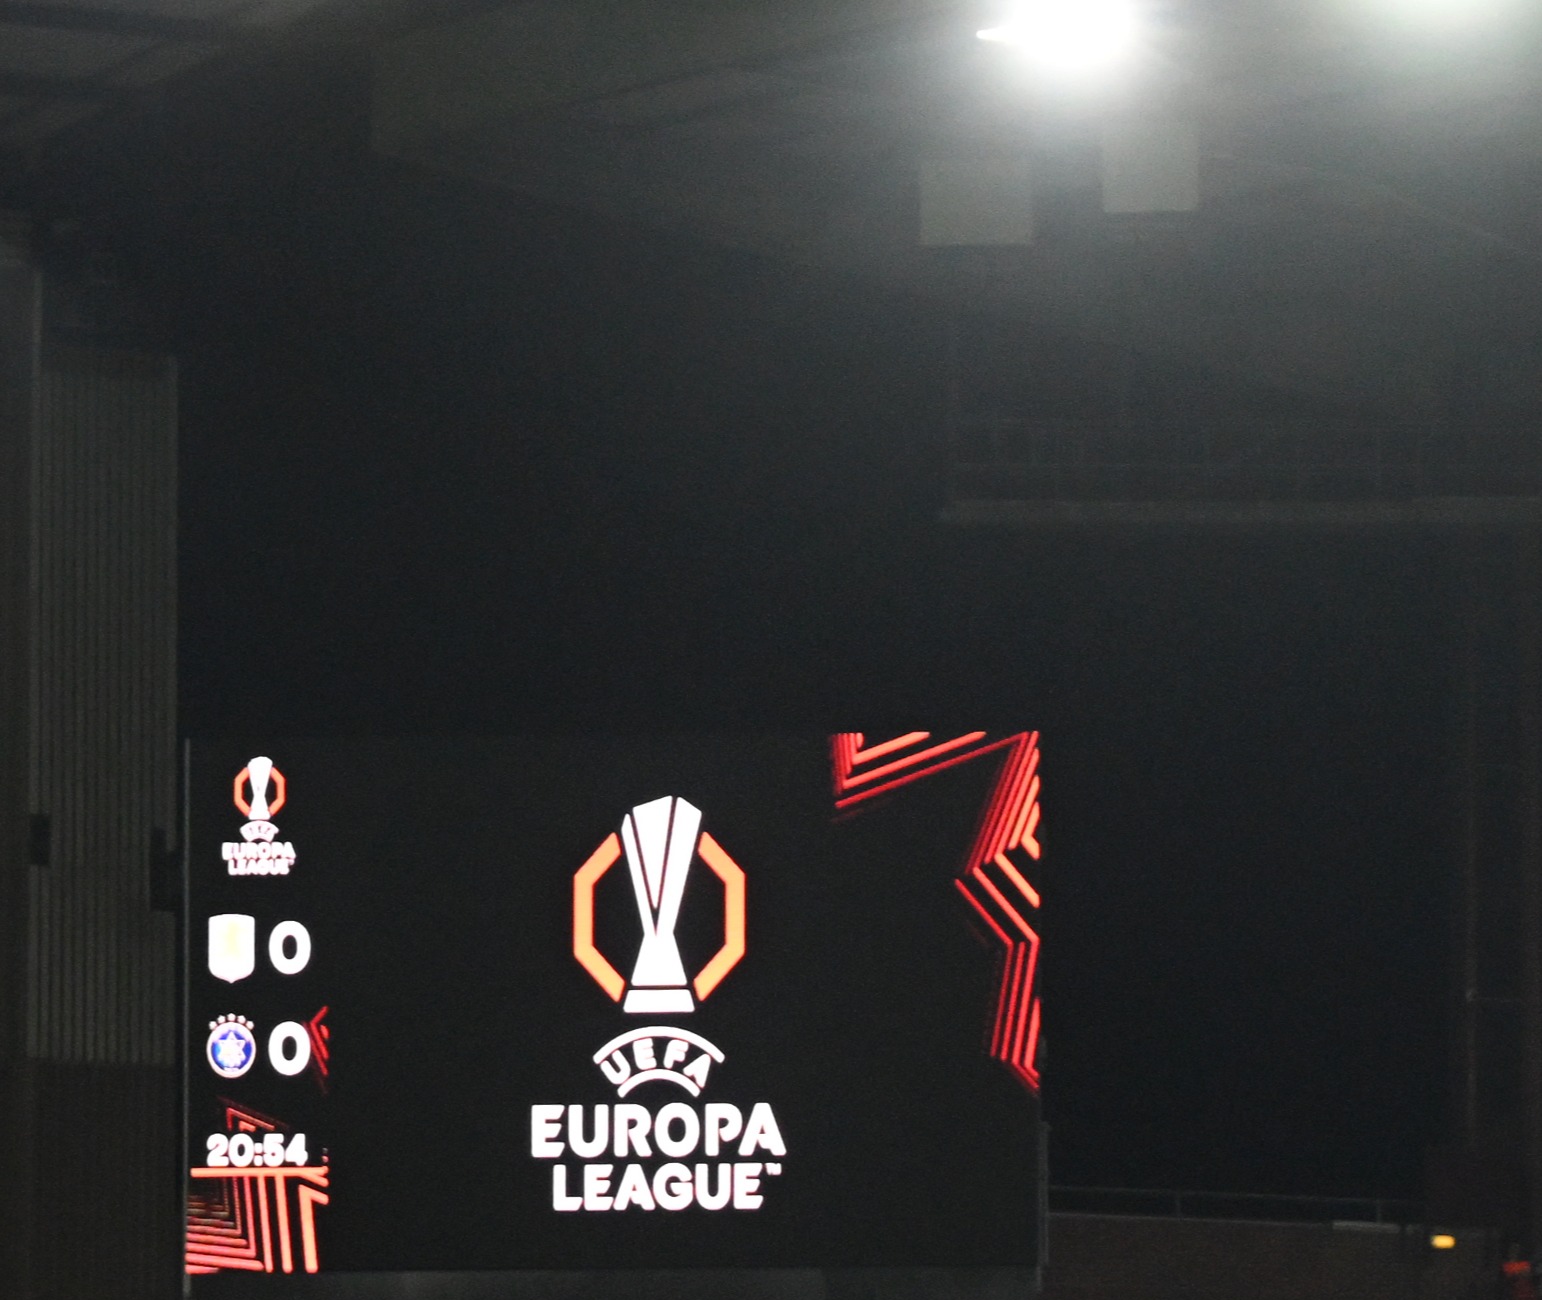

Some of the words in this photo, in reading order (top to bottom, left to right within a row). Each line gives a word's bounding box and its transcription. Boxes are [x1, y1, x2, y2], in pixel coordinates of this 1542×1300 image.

[268, 920, 311, 975] 0
[268, 1021, 311, 1076] 0
[600, 1037, 711, 1085] UEFA
[206, 1133, 308, 1167] 20:54
[531, 1102, 787, 1158] EUROPA
